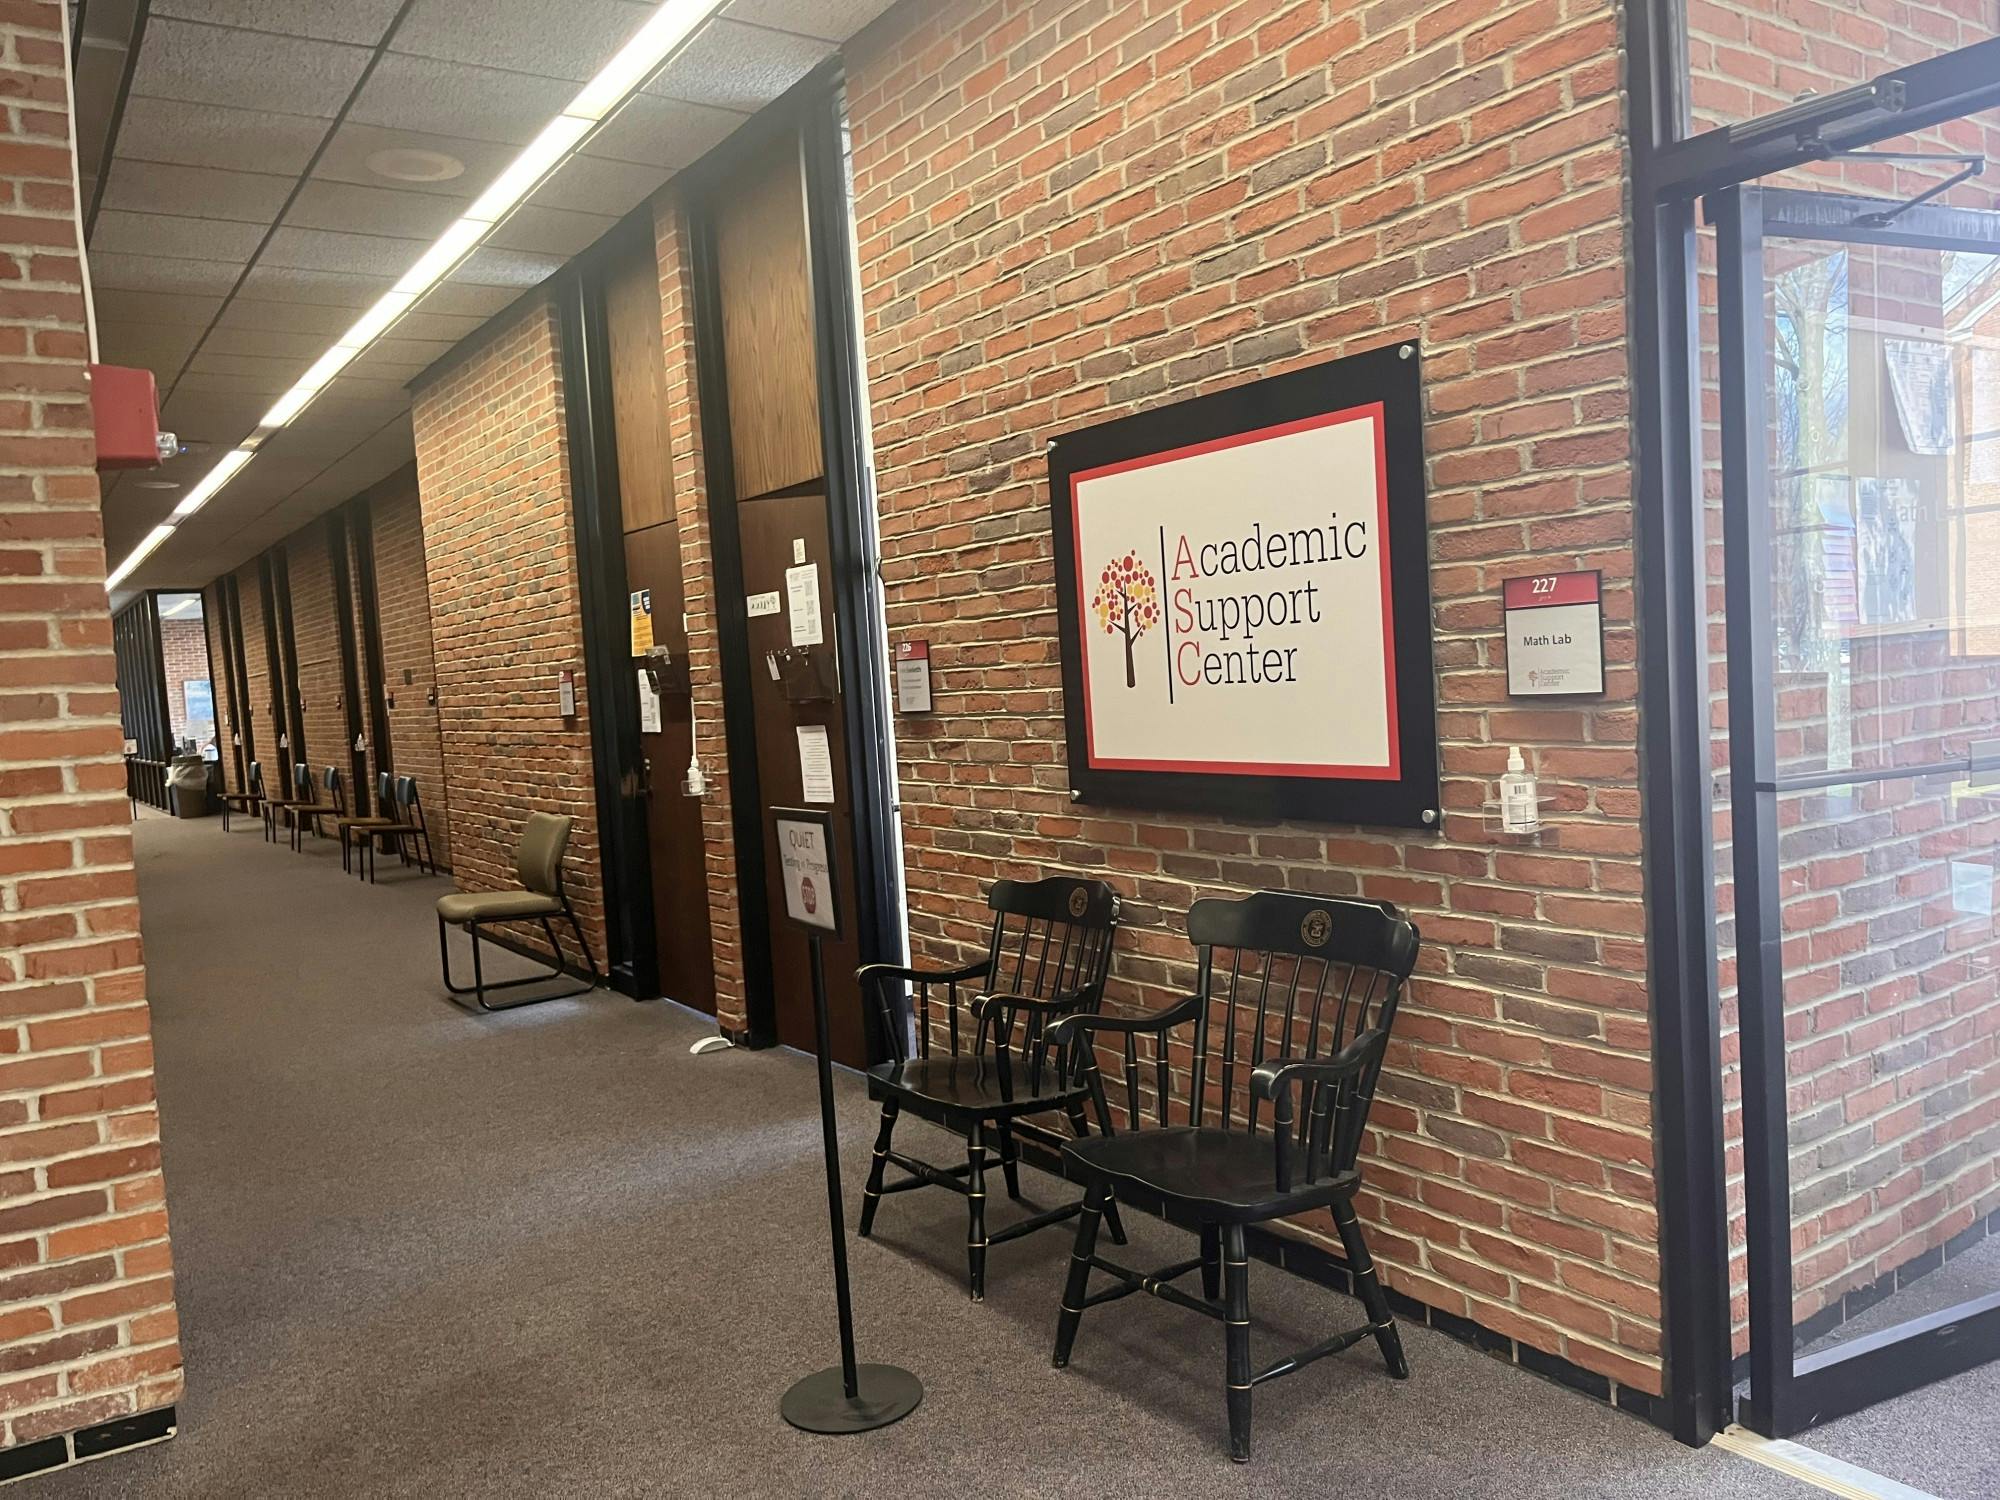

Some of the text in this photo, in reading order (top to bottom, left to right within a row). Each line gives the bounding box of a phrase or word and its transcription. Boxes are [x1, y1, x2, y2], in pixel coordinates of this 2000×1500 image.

[1170, 511, 1367, 581] Academic
[1531, 577, 1557, 594] 227
[1174, 579, 1321, 641] Support
[1523, 633, 1572, 647] Math Lab
[1176, 640, 1299, 687] Center
[789, 830, 814, 851] QUIET
